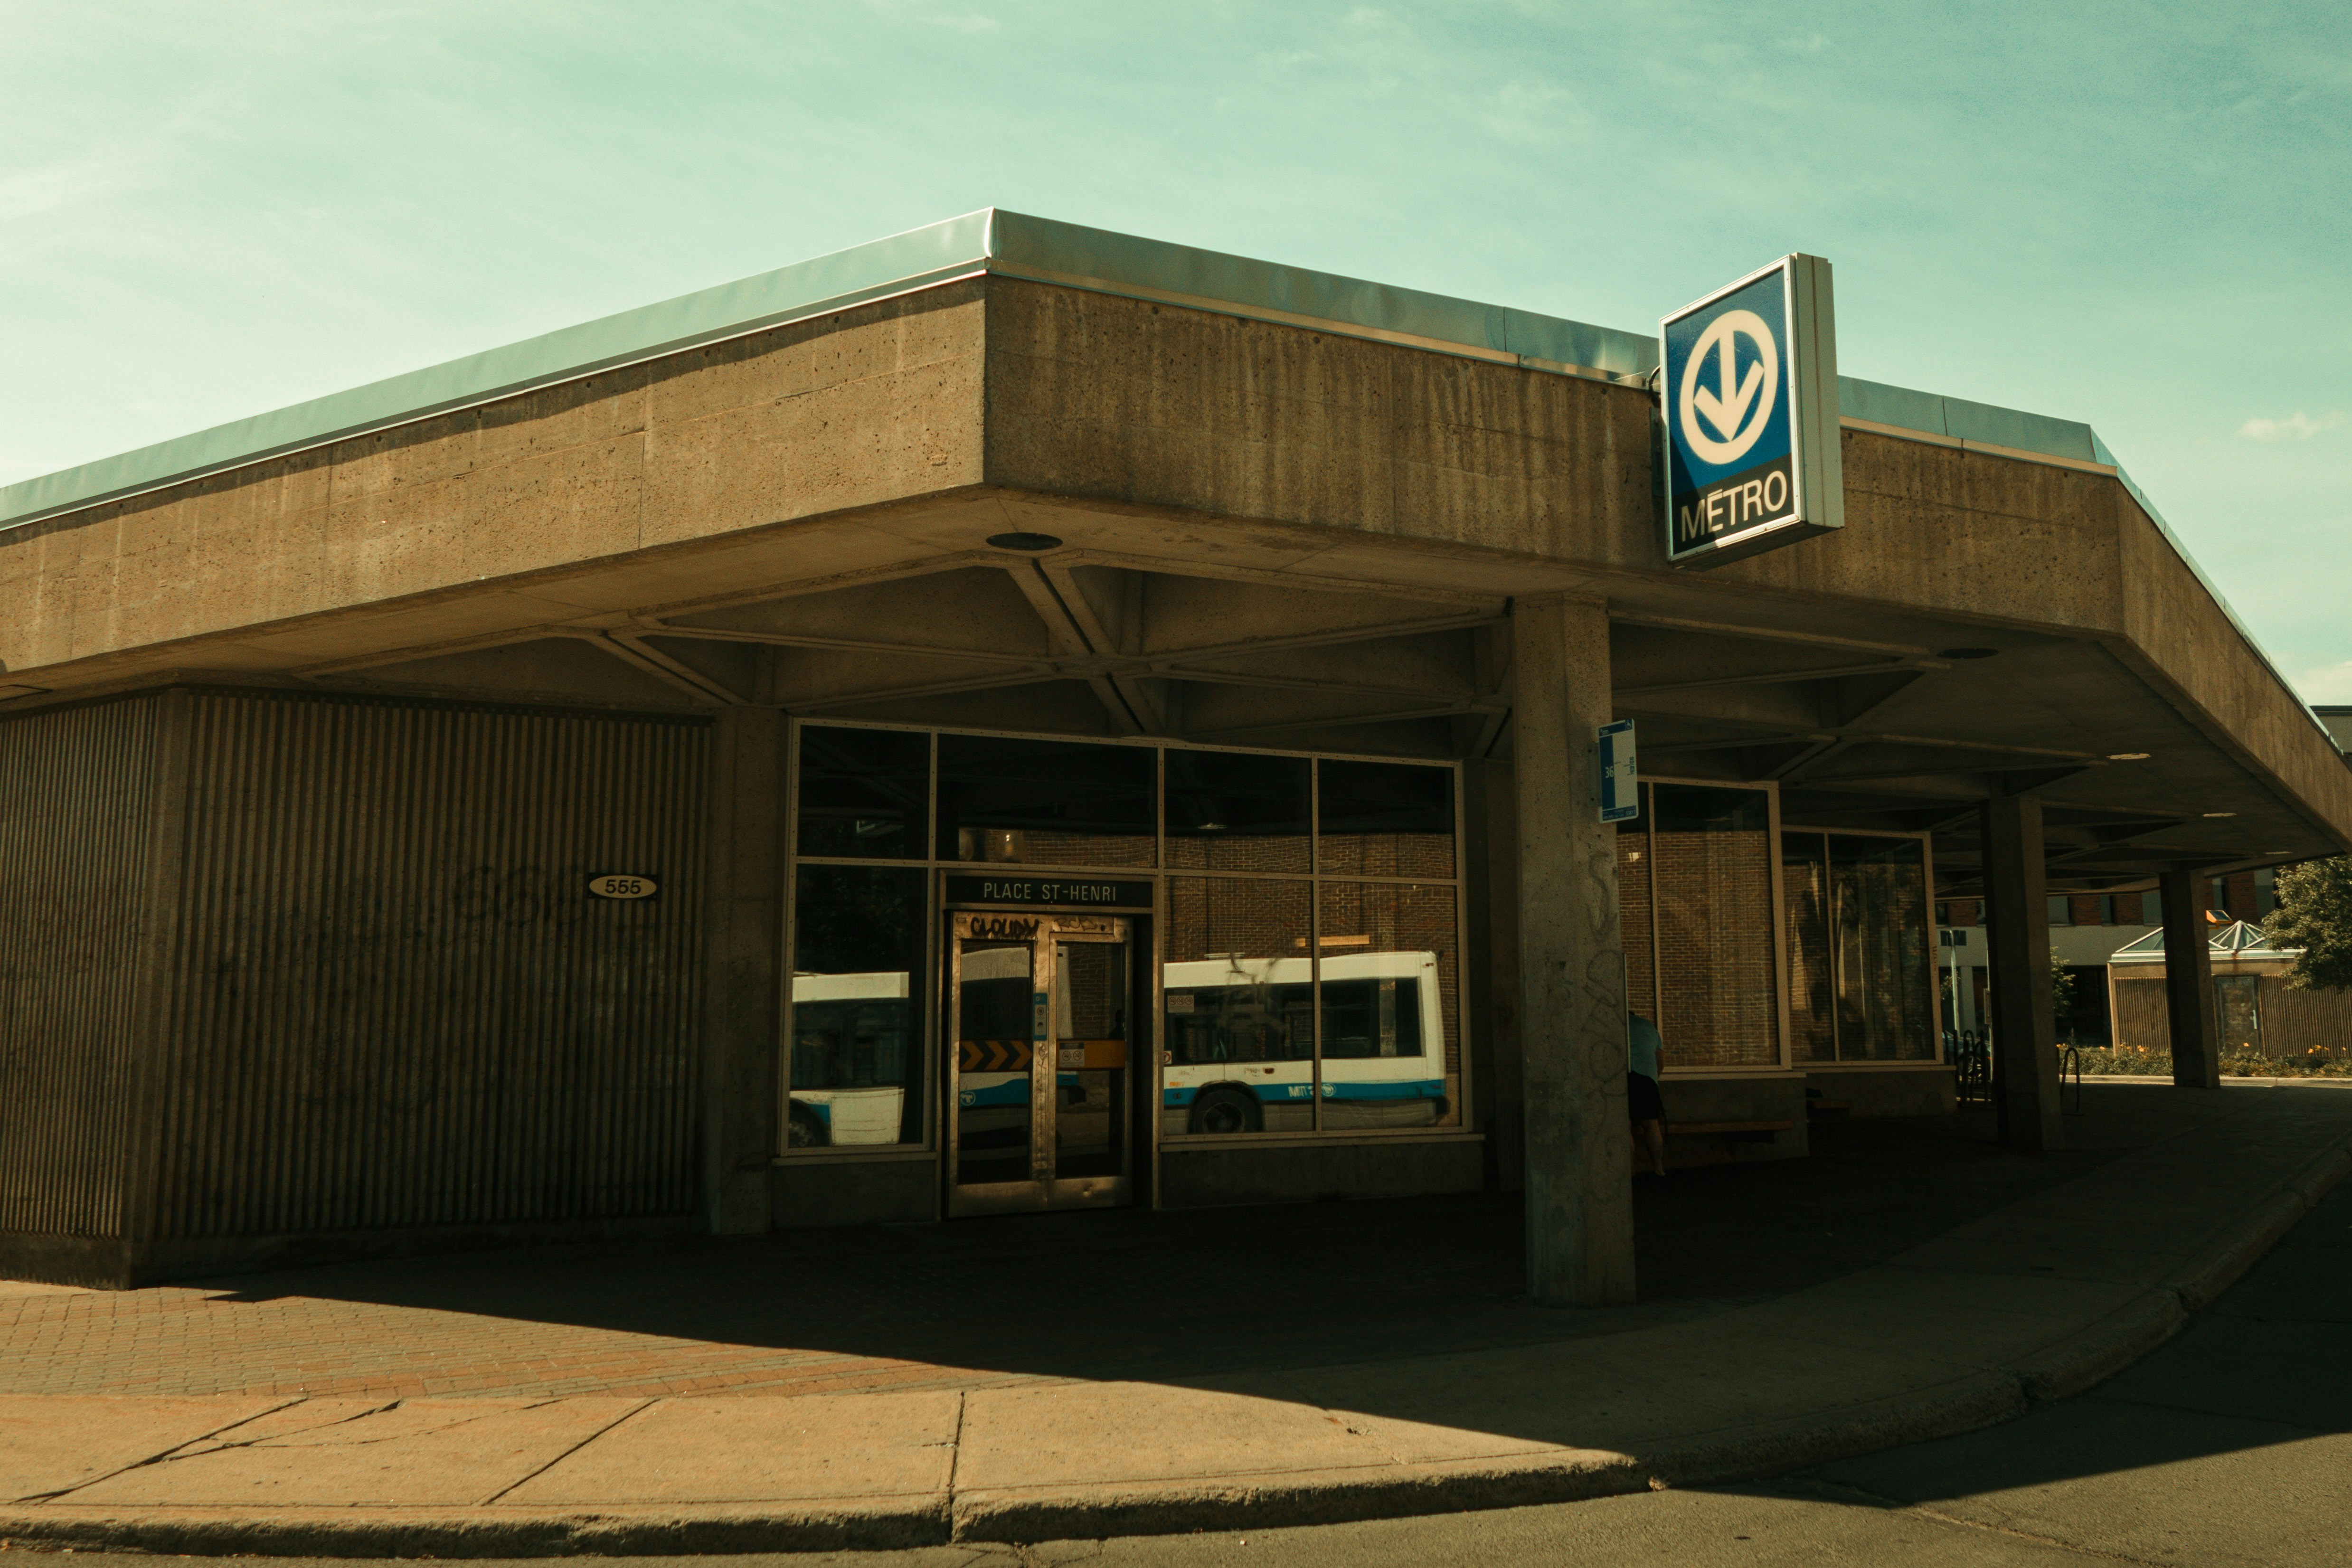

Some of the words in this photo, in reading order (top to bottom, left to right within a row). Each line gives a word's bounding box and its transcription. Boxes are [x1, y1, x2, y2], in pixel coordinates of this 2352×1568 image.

[1605, 766, 1614, 778] 36
[605, 879, 642, 895] 555
[984, 883, 1031, 899] PLACE
[1042, 885, 1116, 901] ST-HENRI
